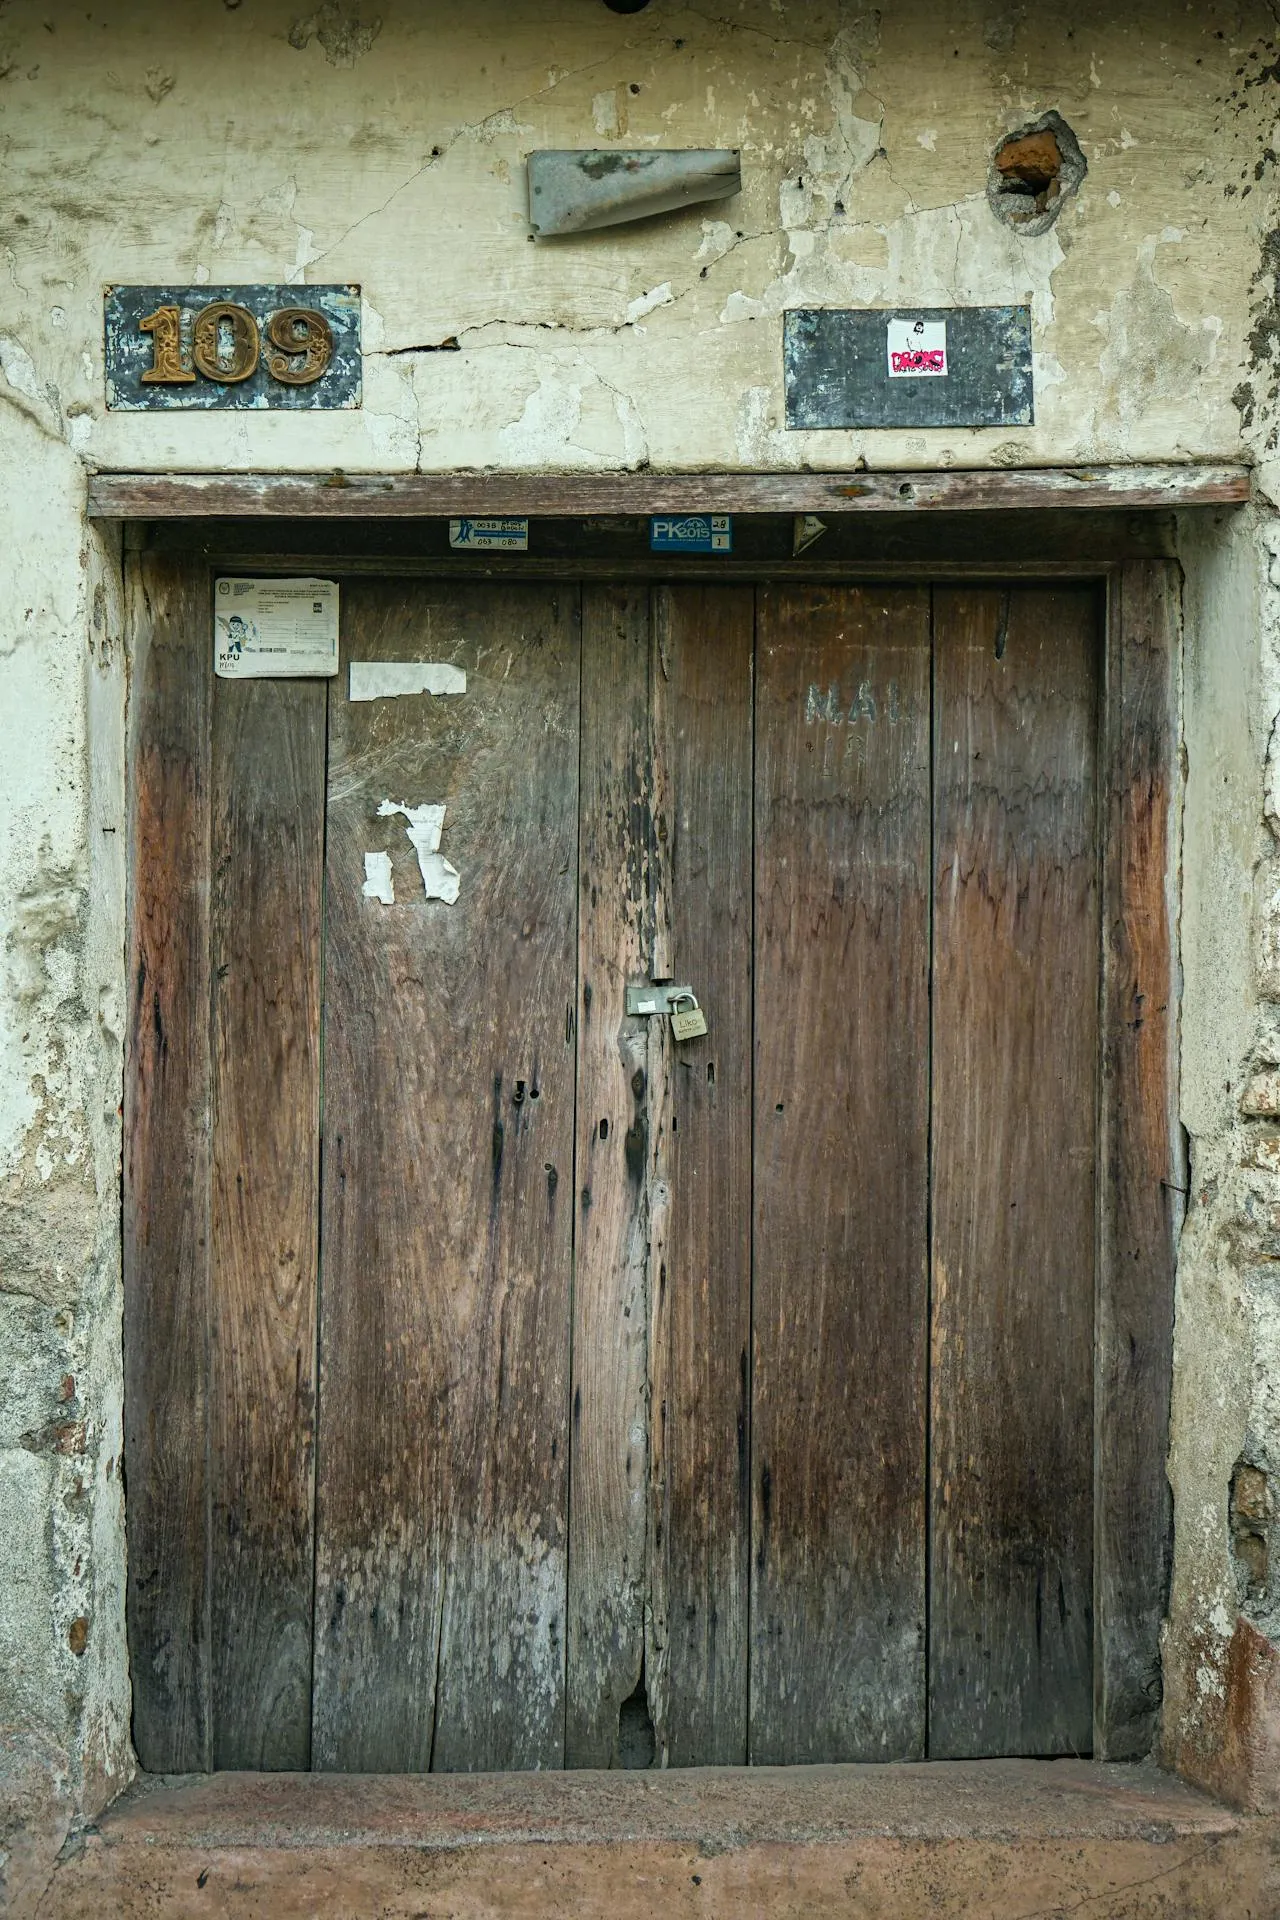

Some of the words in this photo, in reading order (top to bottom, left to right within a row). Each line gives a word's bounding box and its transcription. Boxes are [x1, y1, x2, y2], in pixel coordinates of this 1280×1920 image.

[139, 302, 334, 385] 109
[679, 527, 710, 538] 2015
[219, 653, 240, 661] KPU
